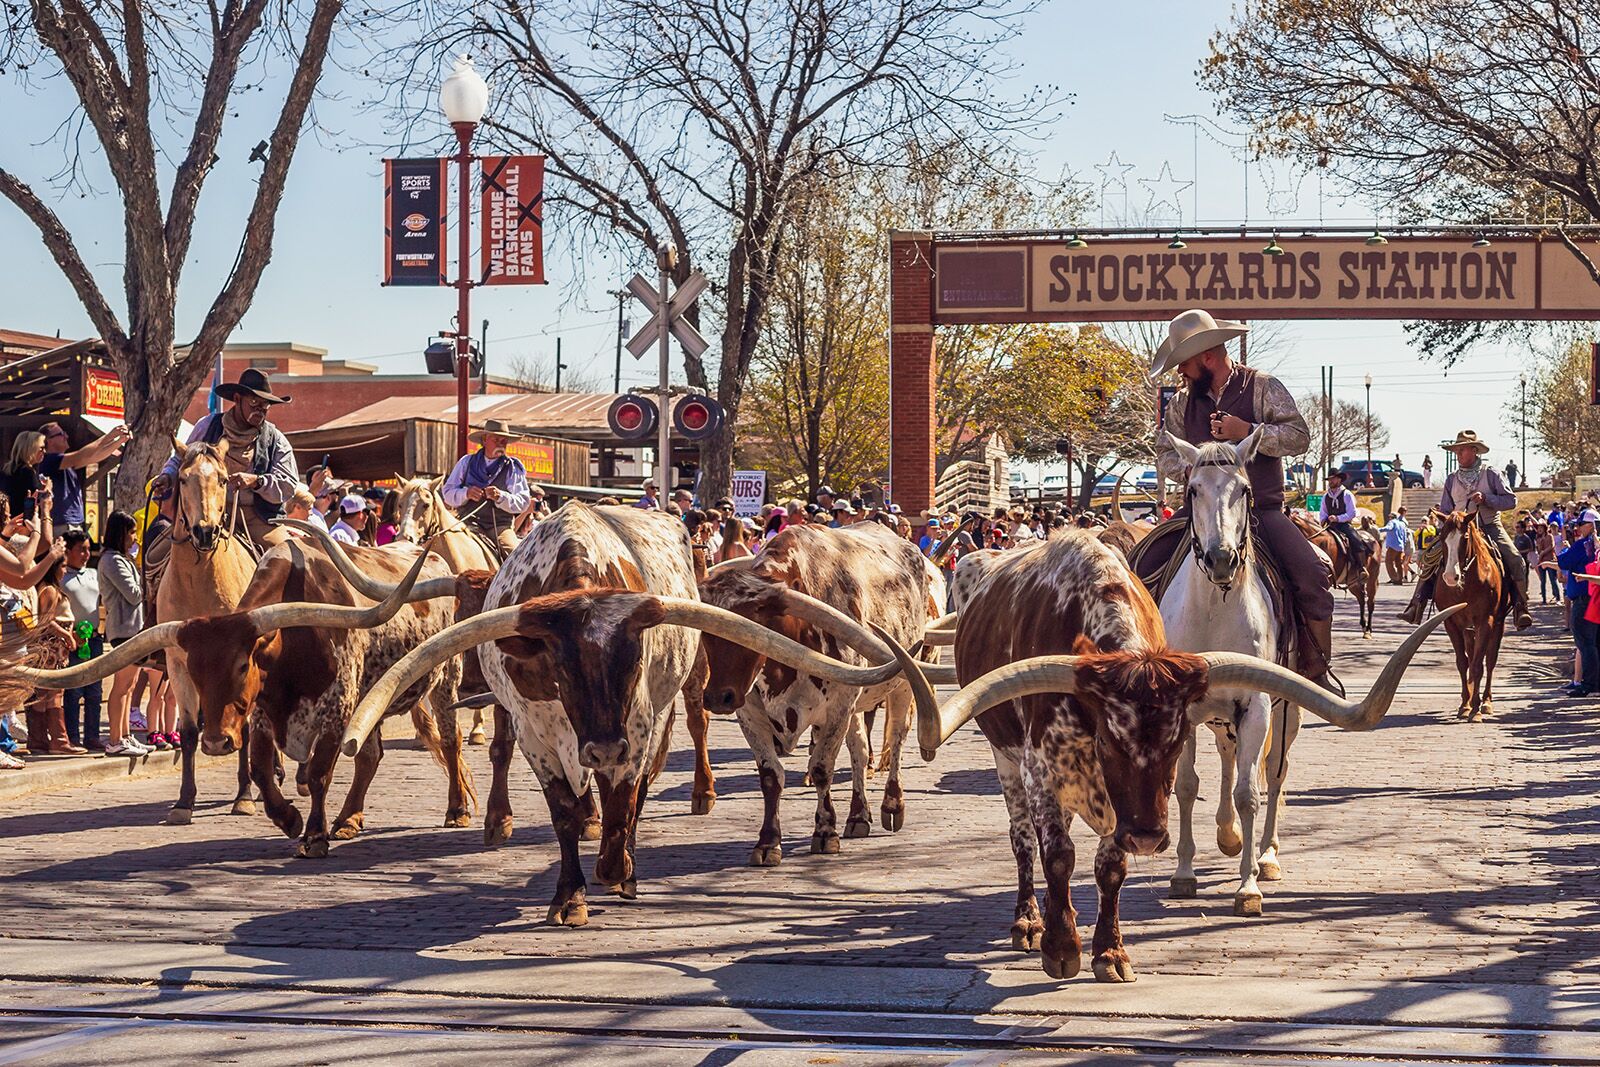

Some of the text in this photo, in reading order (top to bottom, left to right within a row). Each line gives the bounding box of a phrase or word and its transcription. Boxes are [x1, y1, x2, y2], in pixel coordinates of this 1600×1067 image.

[401, 179, 431, 187] SPORTS
[491, 191, 504, 276] WELCOME
[506, 165, 519, 276] BASKETBALL
[520, 230, 534, 276] FANS
[1049, 251, 1517, 302] STOCKYARDS STATION
